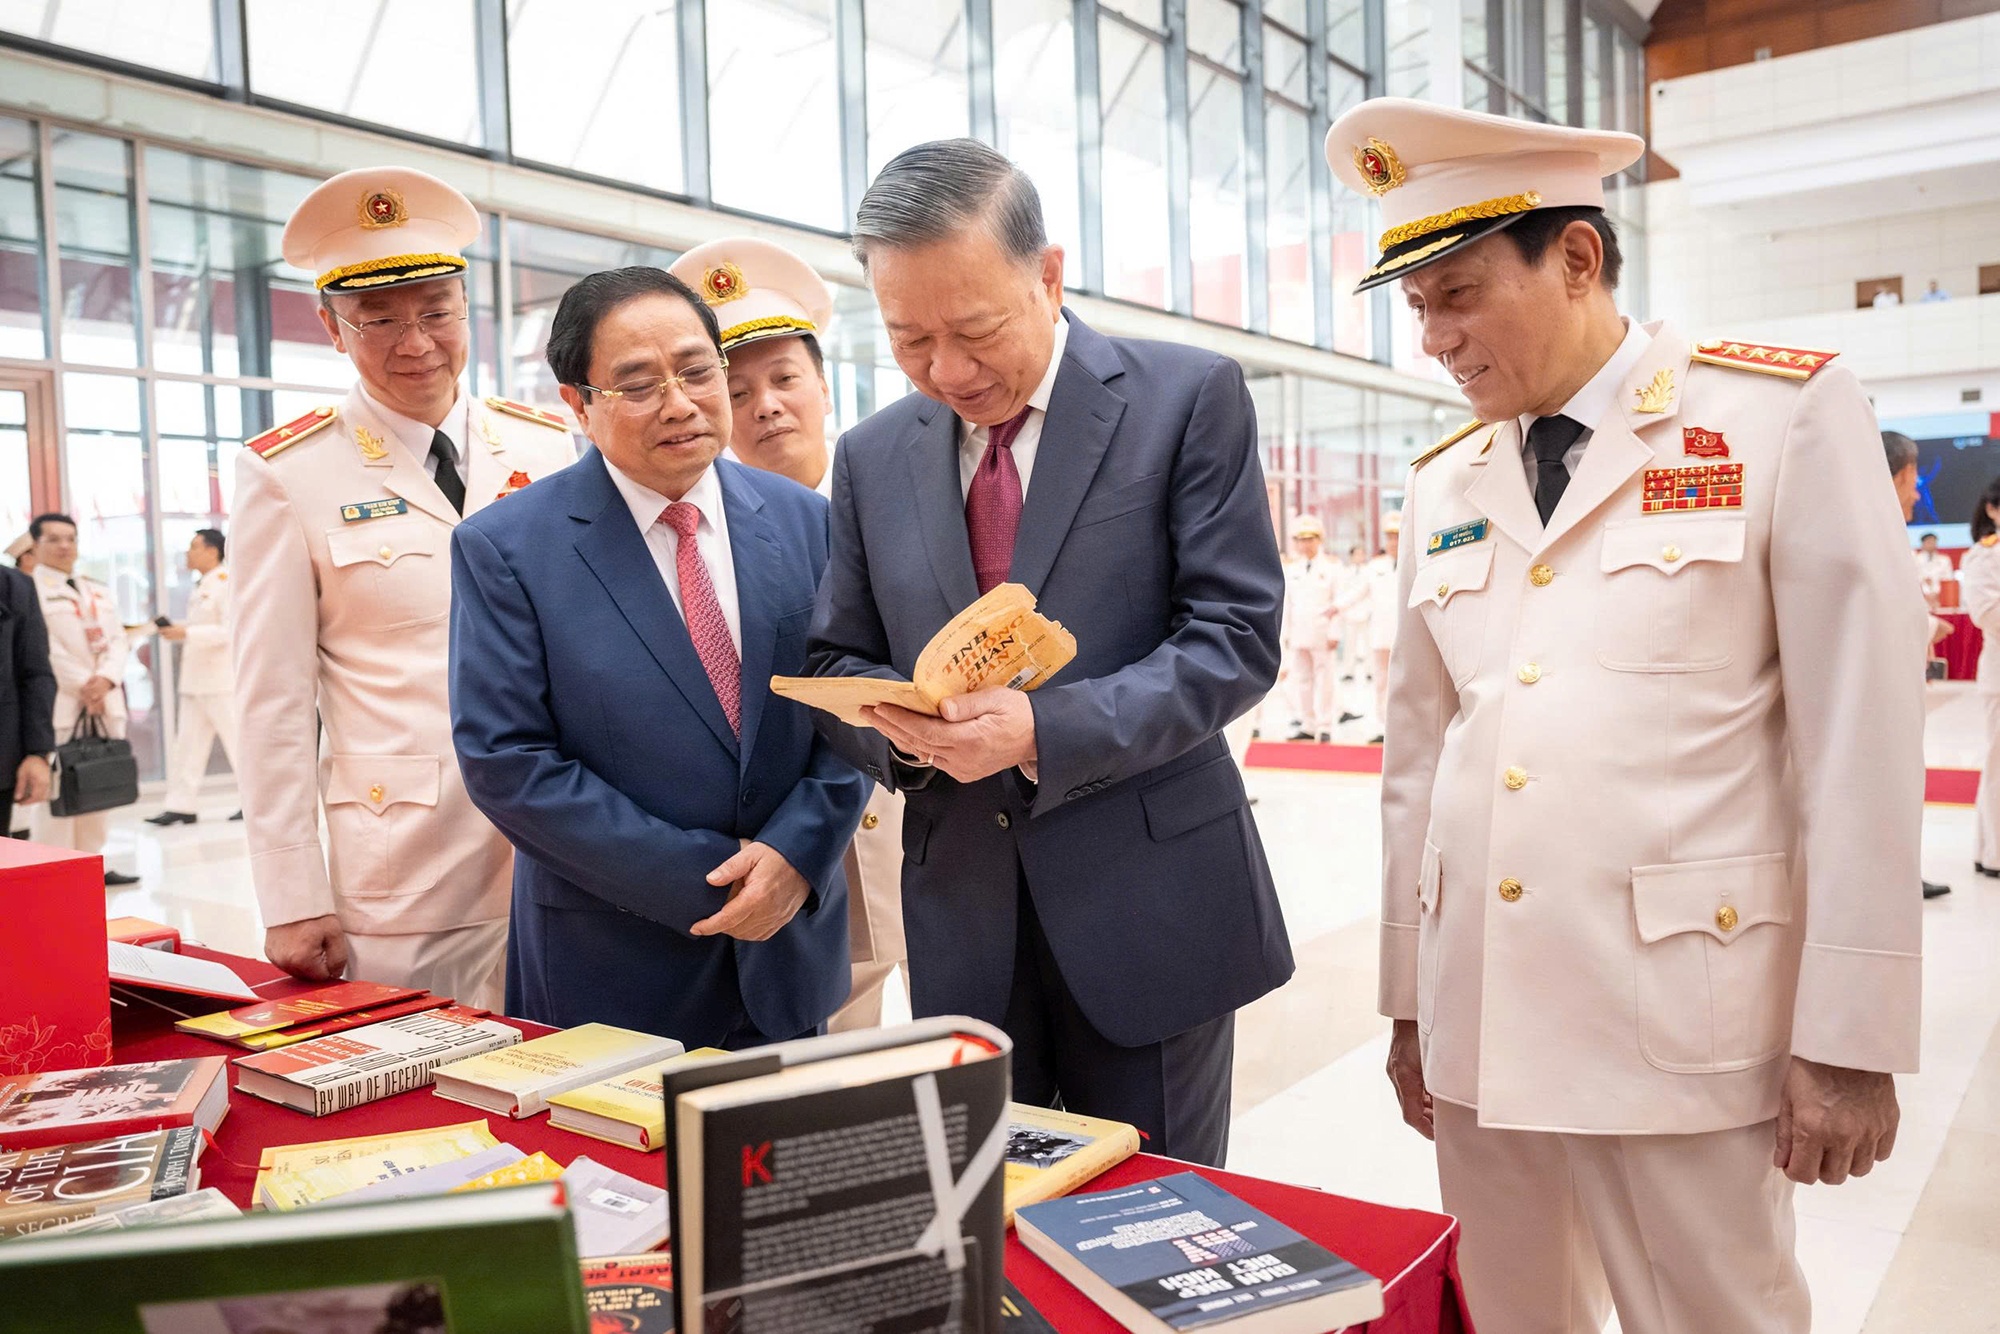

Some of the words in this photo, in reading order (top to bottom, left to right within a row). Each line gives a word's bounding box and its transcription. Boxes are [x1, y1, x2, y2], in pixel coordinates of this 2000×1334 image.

[319, 1088, 334, 1115] BY
[338, 1080, 361, 1110] WAY
[366, 1075, 380, 1101] OF
[169, 1127, 195, 1155] TRENTO
[17, 1150, 65, 1183] THE
[53, 1130, 162, 1199] CIA
[5, 1184, 49, 1204] OF
